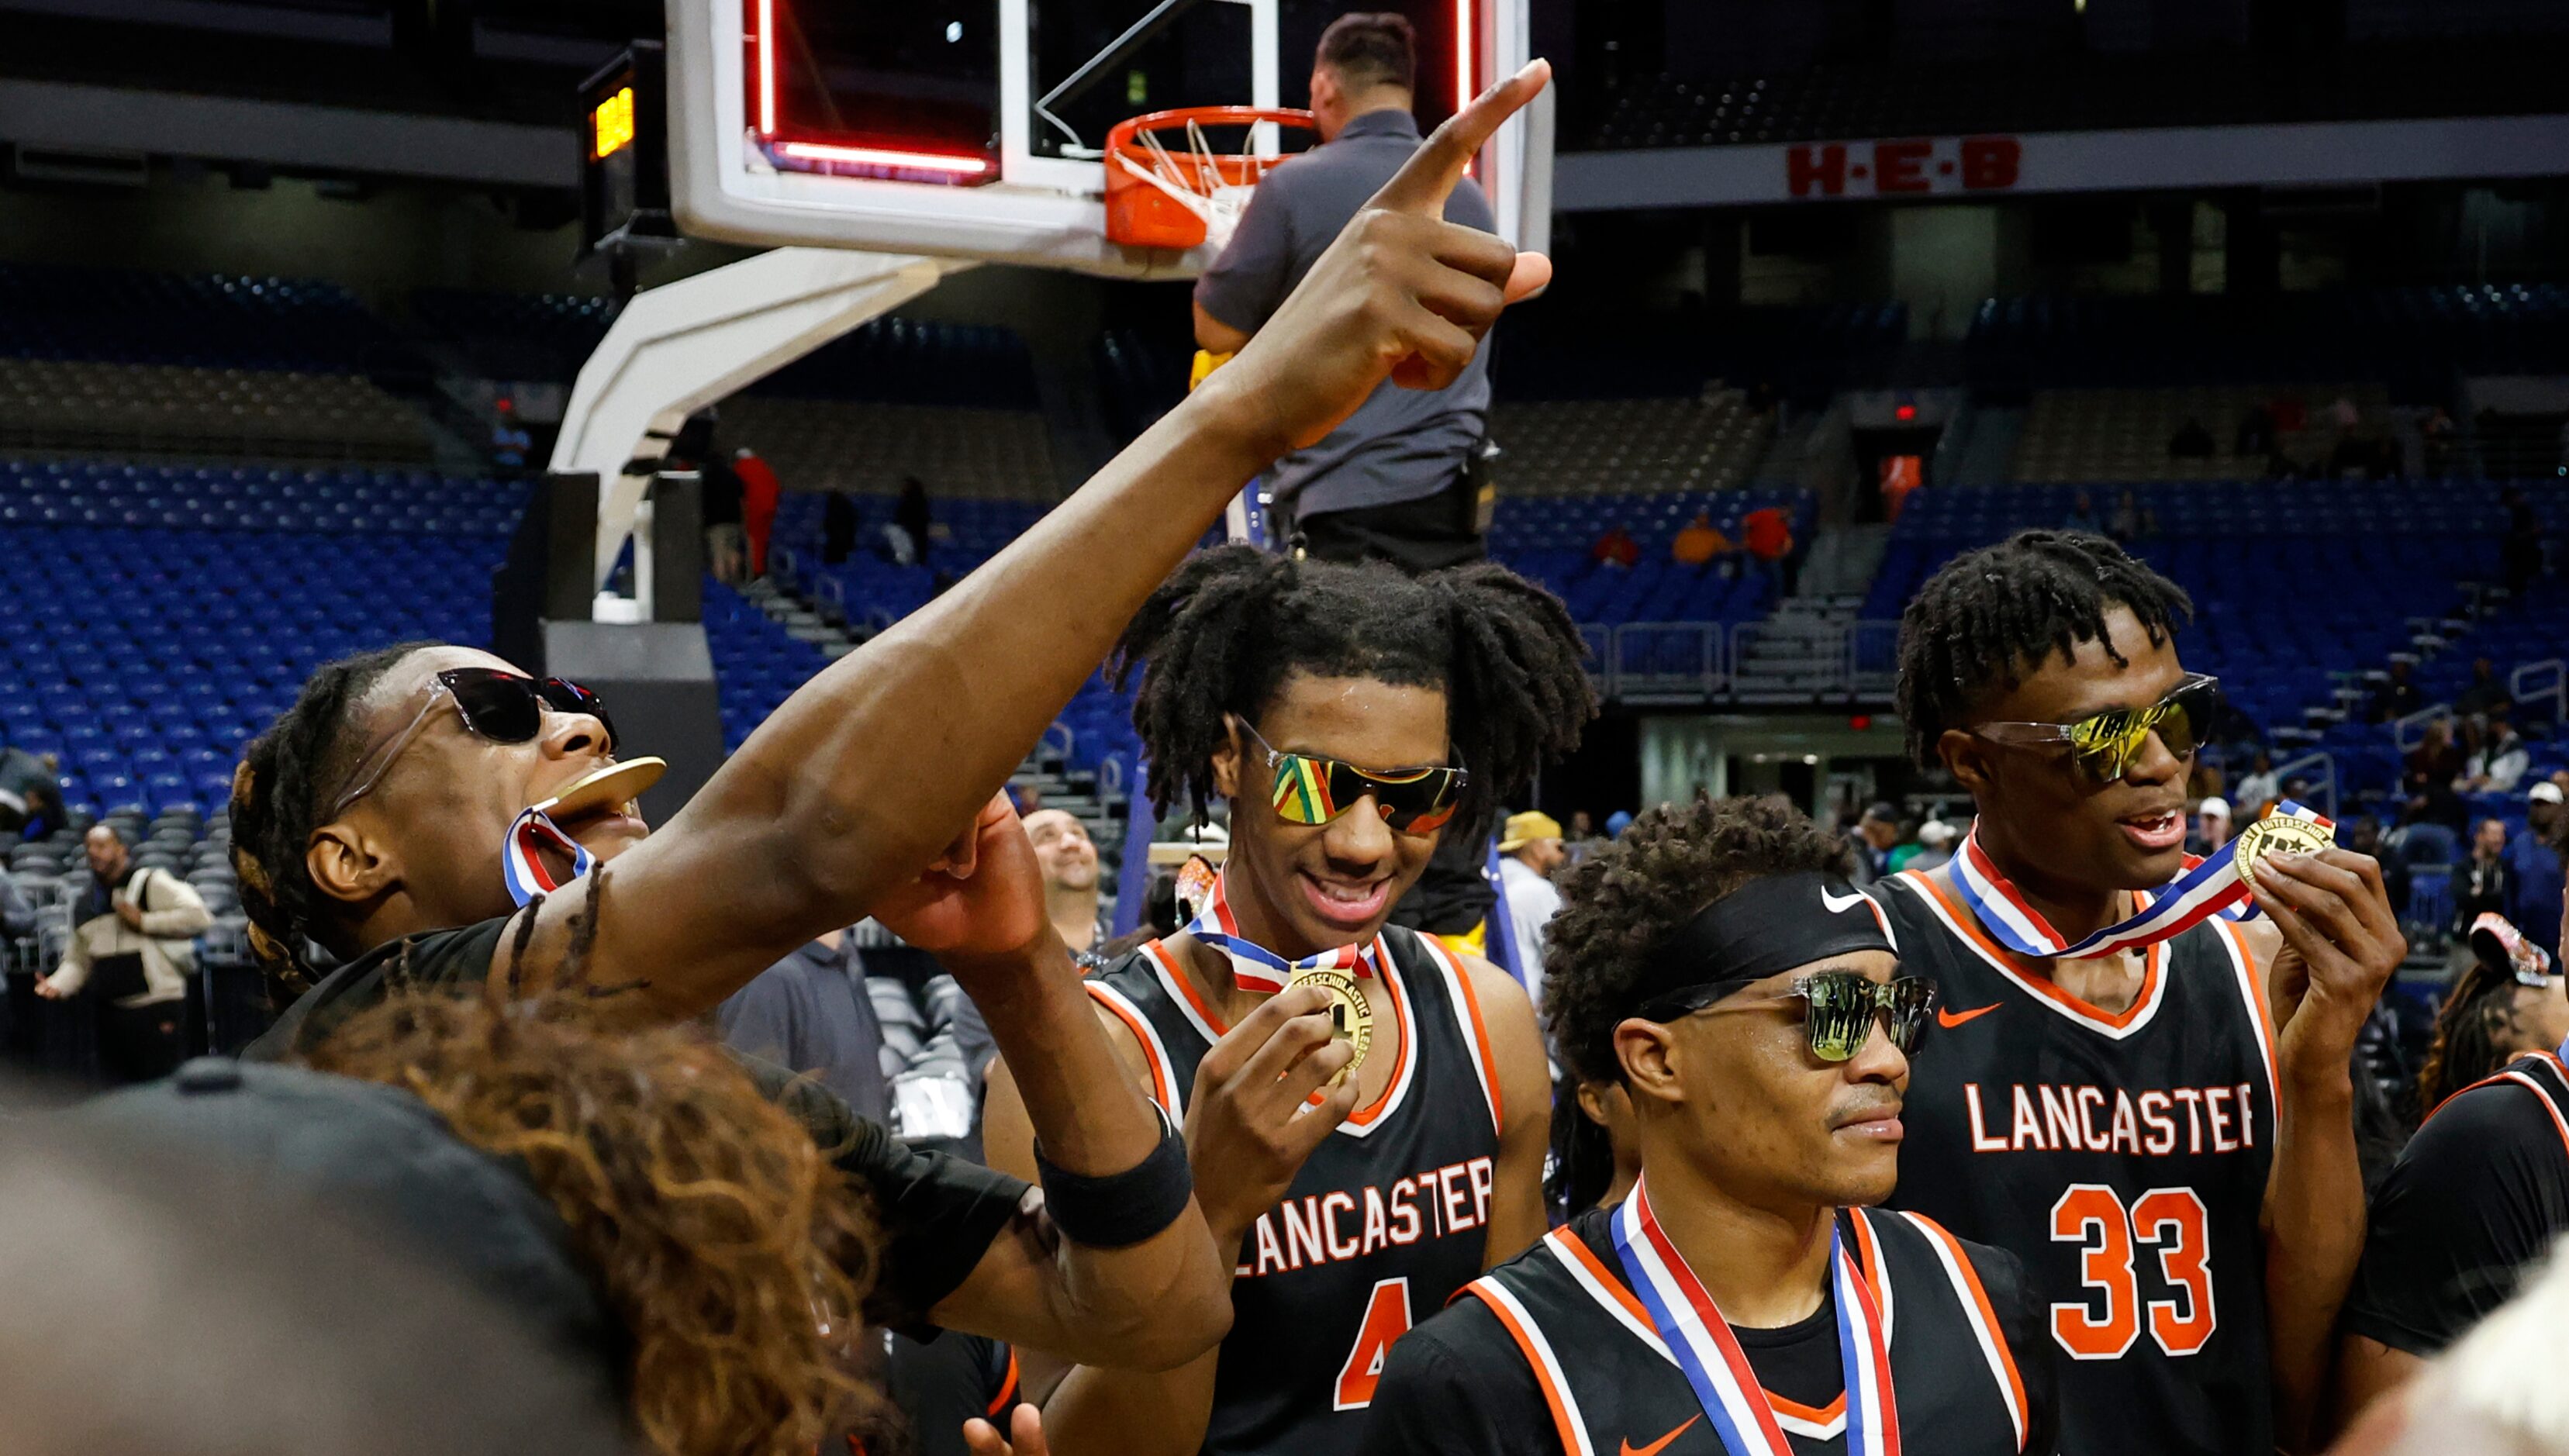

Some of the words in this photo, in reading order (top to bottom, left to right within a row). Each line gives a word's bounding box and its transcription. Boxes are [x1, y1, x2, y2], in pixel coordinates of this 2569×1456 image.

[1234, 1155, 1493, 1278] ANCASTER
[2050, 1184, 2217, 1360] 33
[1333, 1276, 1413, 1412] 4
